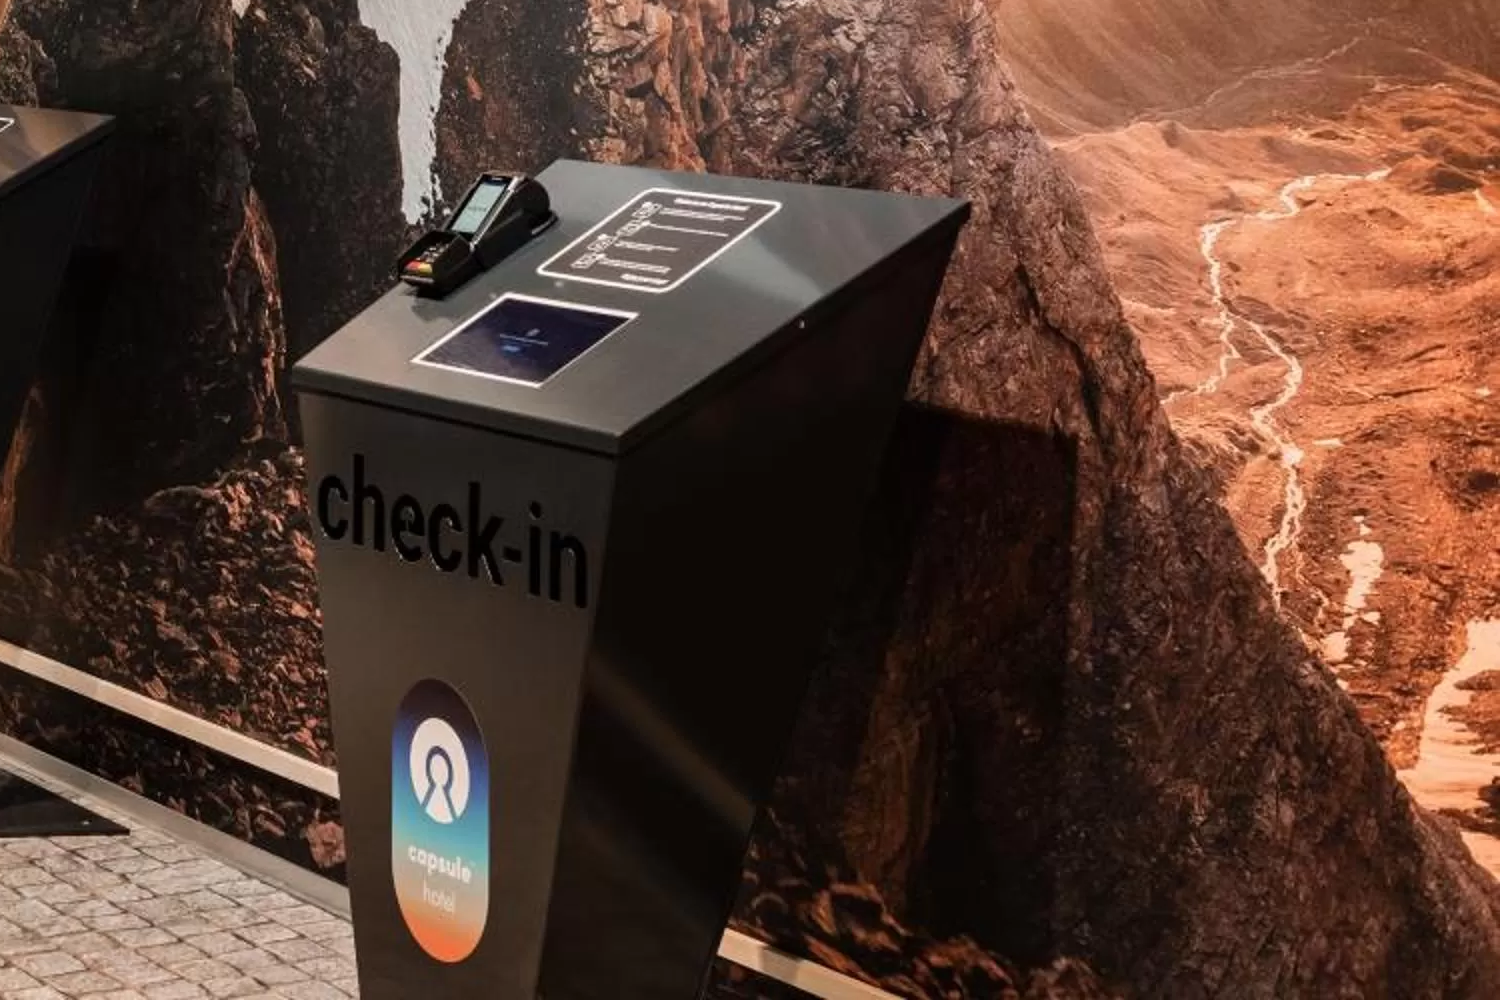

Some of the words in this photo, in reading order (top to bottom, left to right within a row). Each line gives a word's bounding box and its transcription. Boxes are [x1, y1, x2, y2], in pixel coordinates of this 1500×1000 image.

[317, 453, 587, 608] check-in
[407, 844, 472, 885] capsule
[423, 879, 456, 915] hotel
